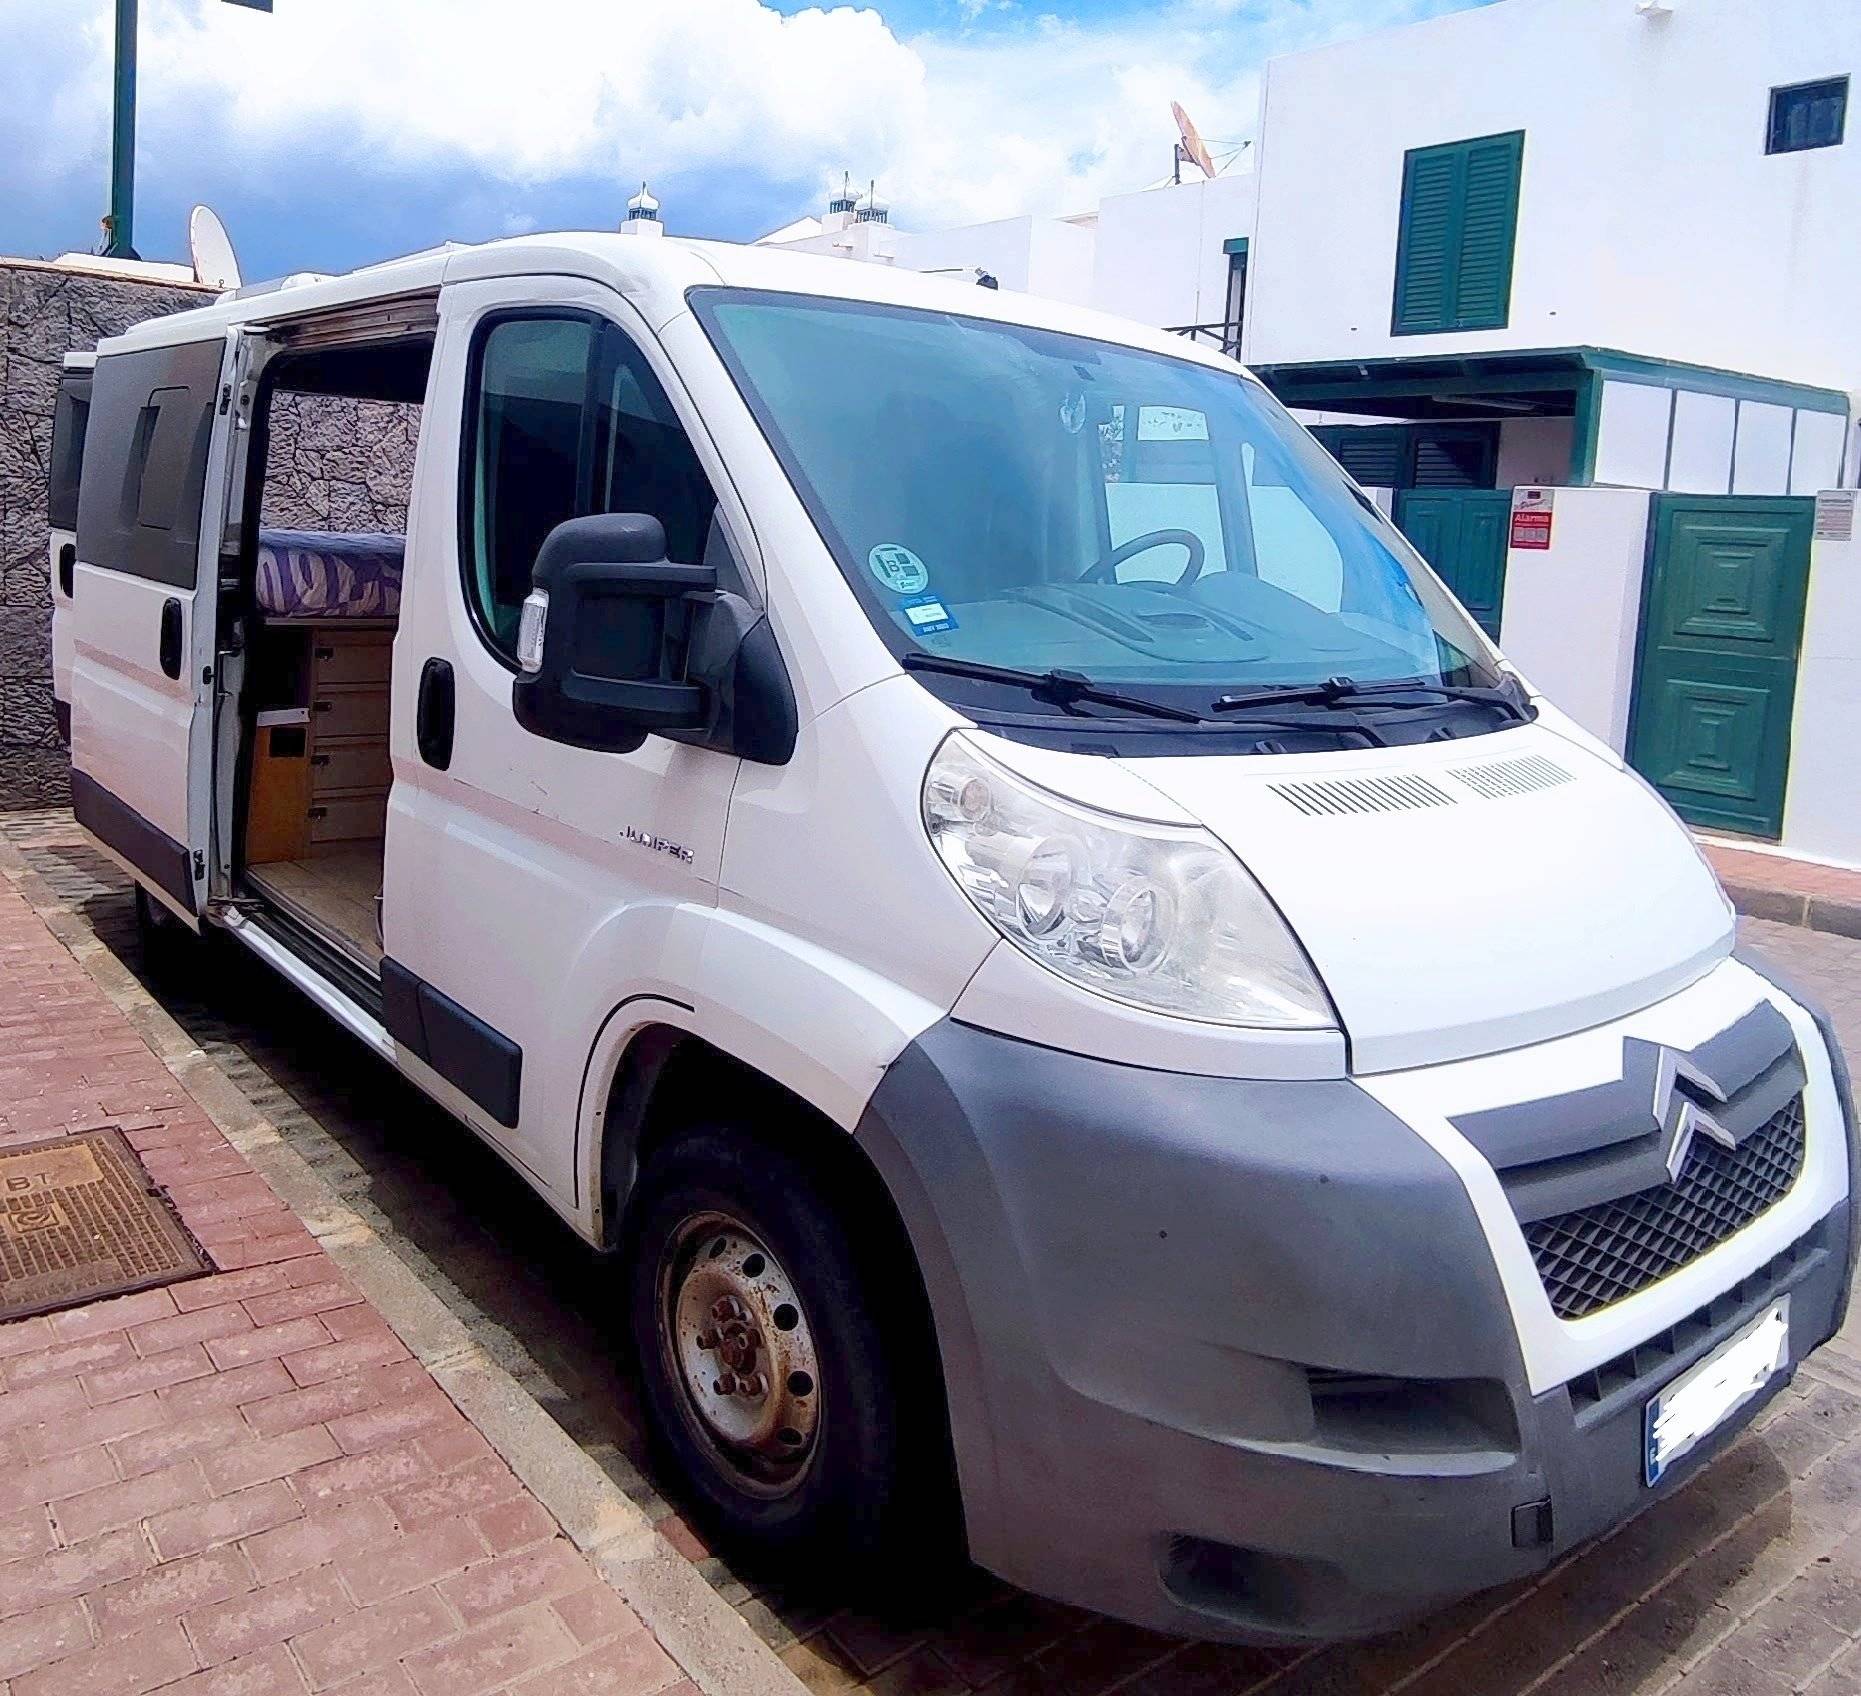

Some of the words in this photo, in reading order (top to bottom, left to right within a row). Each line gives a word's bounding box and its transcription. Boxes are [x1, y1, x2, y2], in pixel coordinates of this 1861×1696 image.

[1515, 514, 1549, 523] Alarma
[886, 560, 899, 572] B
[620, 825, 695, 865] JUMPER
